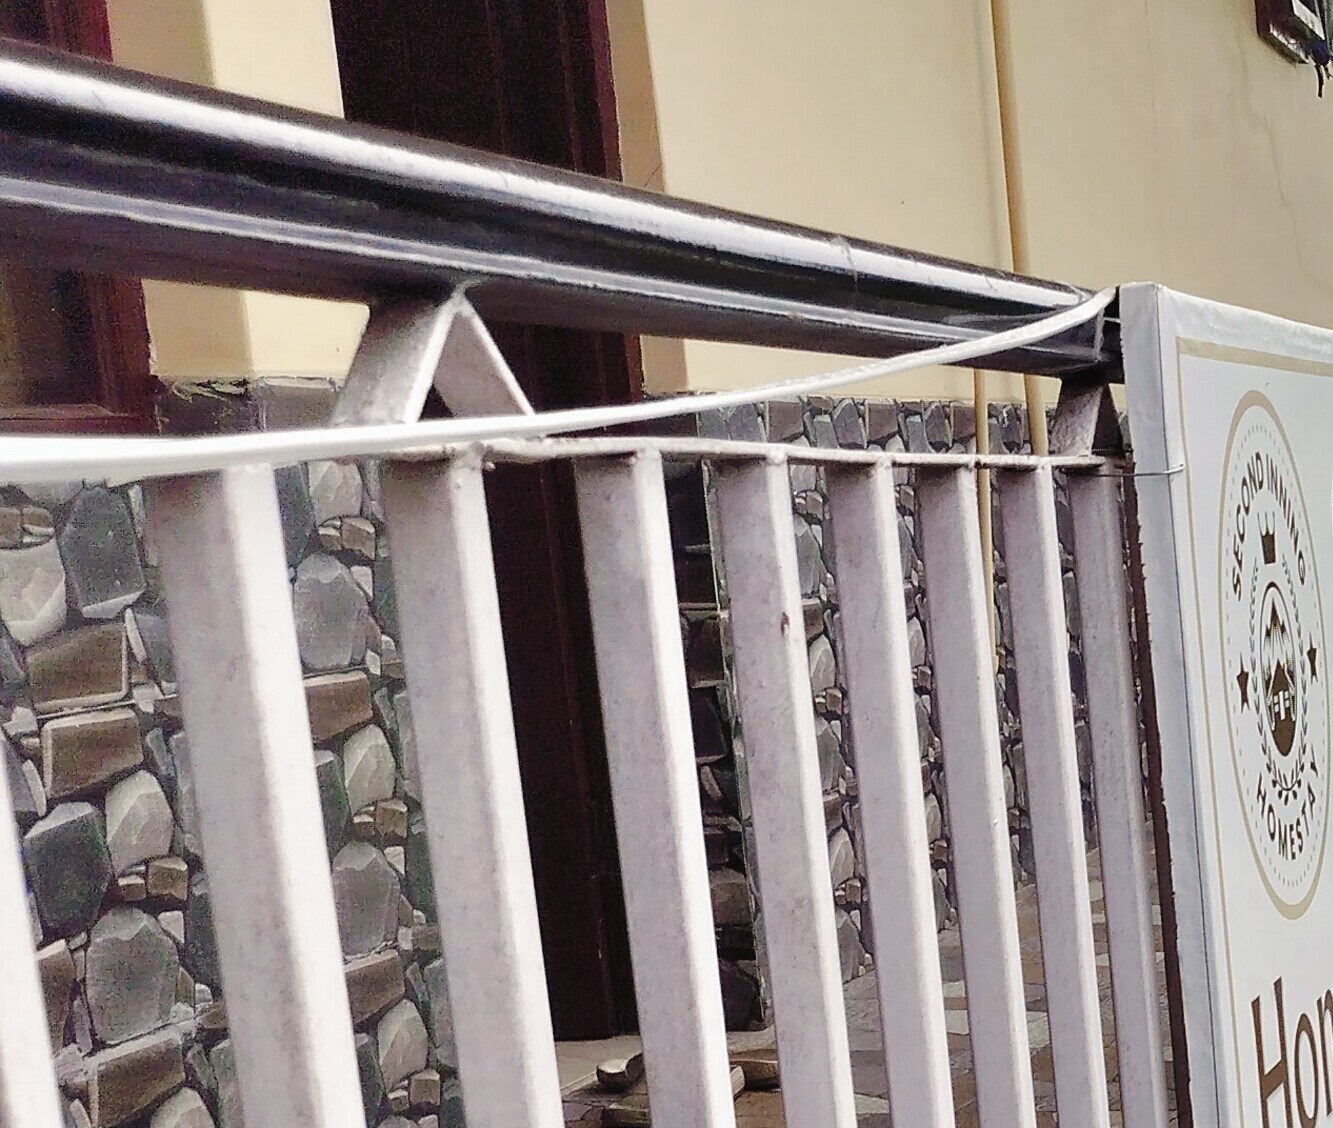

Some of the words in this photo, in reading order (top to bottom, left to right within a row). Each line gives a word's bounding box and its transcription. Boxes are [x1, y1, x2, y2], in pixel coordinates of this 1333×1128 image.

[1232, 451, 1264, 602] SECOND
[1265, 453, 1306, 586] INNING
[1256, 743, 1319, 861] HOMESTAY
